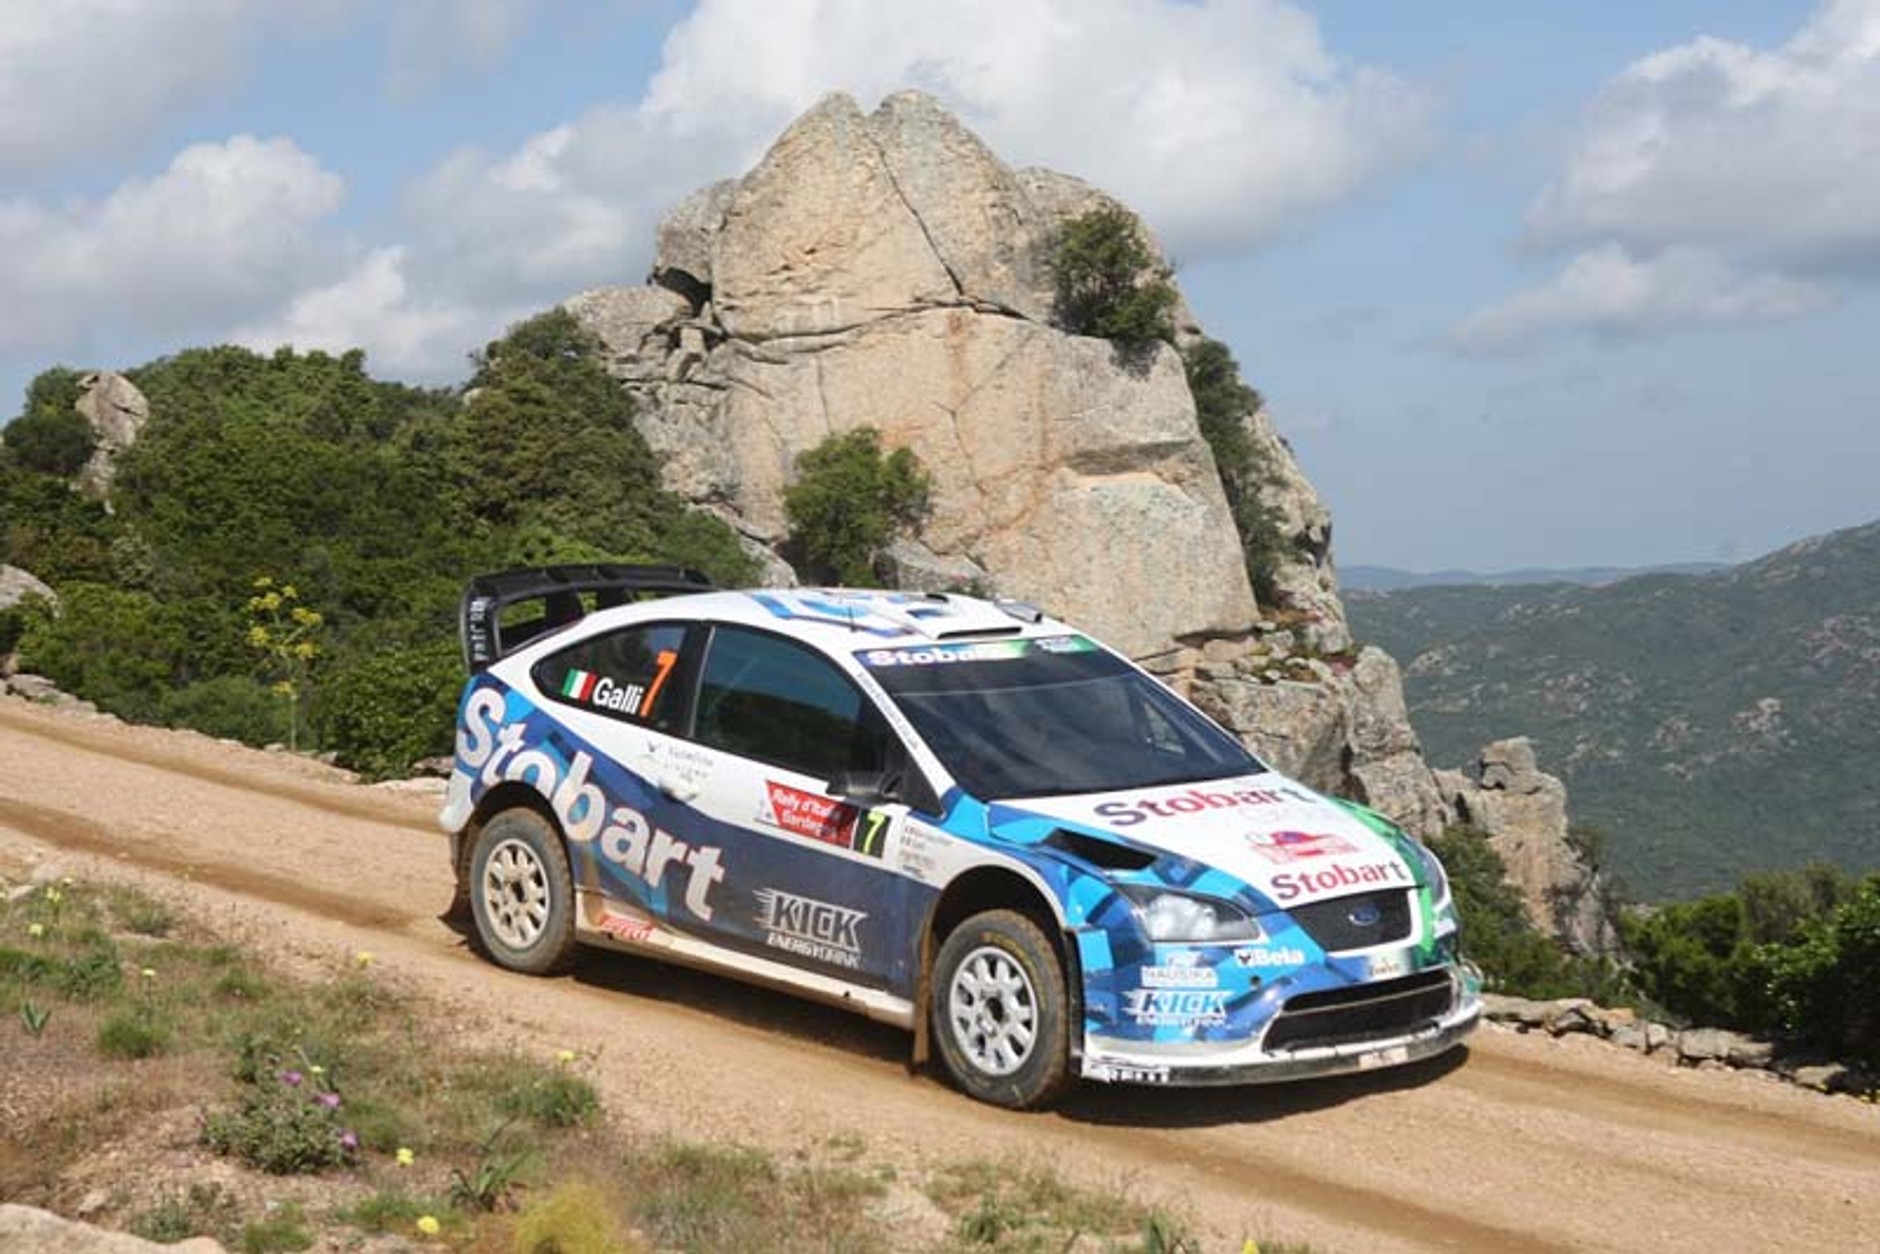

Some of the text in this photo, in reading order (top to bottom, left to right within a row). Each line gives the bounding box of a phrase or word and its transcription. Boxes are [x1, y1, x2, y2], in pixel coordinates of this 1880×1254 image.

[866, 644, 992, 666] Stoba
[592, 677, 644, 716] Galli
[640, 649, 678, 718] 7
[456, 687, 724, 921] Stobart
[772, 789, 800, 813] Rally
[1094, 787, 1317, 827] Stobart
[862, 809, 886, 856] 7
[1270, 861, 1407, 901] Stobart
[769, 892, 867, 951] KICK
[1140, 990, 1229, 1017] KICK
